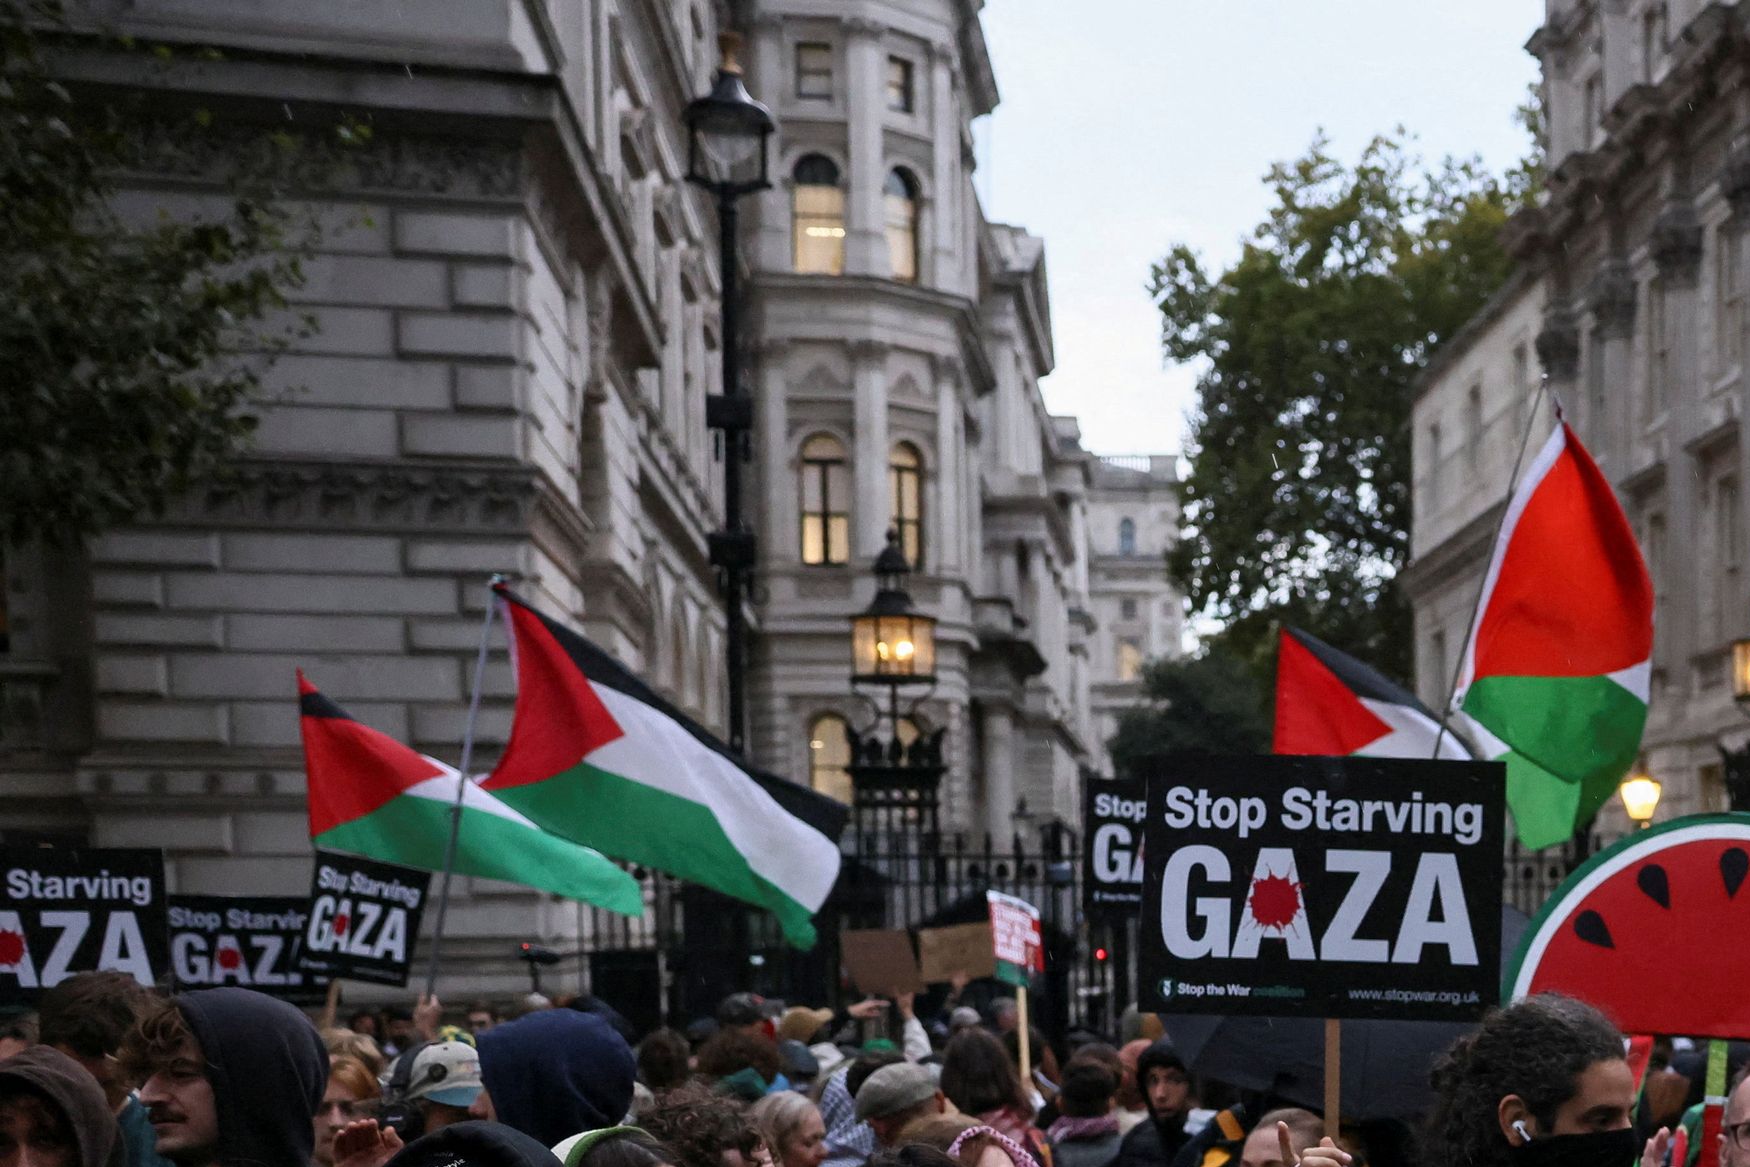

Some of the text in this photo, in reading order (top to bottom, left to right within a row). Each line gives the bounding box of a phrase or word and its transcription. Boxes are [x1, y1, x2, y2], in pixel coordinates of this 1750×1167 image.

[1165, 786, 1483, 845] Stop Starving
[6, 868, 152, 907] Starving
[1160, 844, 1480, 967] GAZA
[168, 906, 222, 932] Stop
[307, 894, 408, 964] GAZA
[0, 910, 156, 988] AZA
[171, 931, 303, 985] GAZ
[1177, 982, 1204, 998] Stop
[1206, 983, 1225, 997] the
[1226, 984, 1251, 998] War
[1348, 987, 1480, 1005] www.stopwar.org.uk
